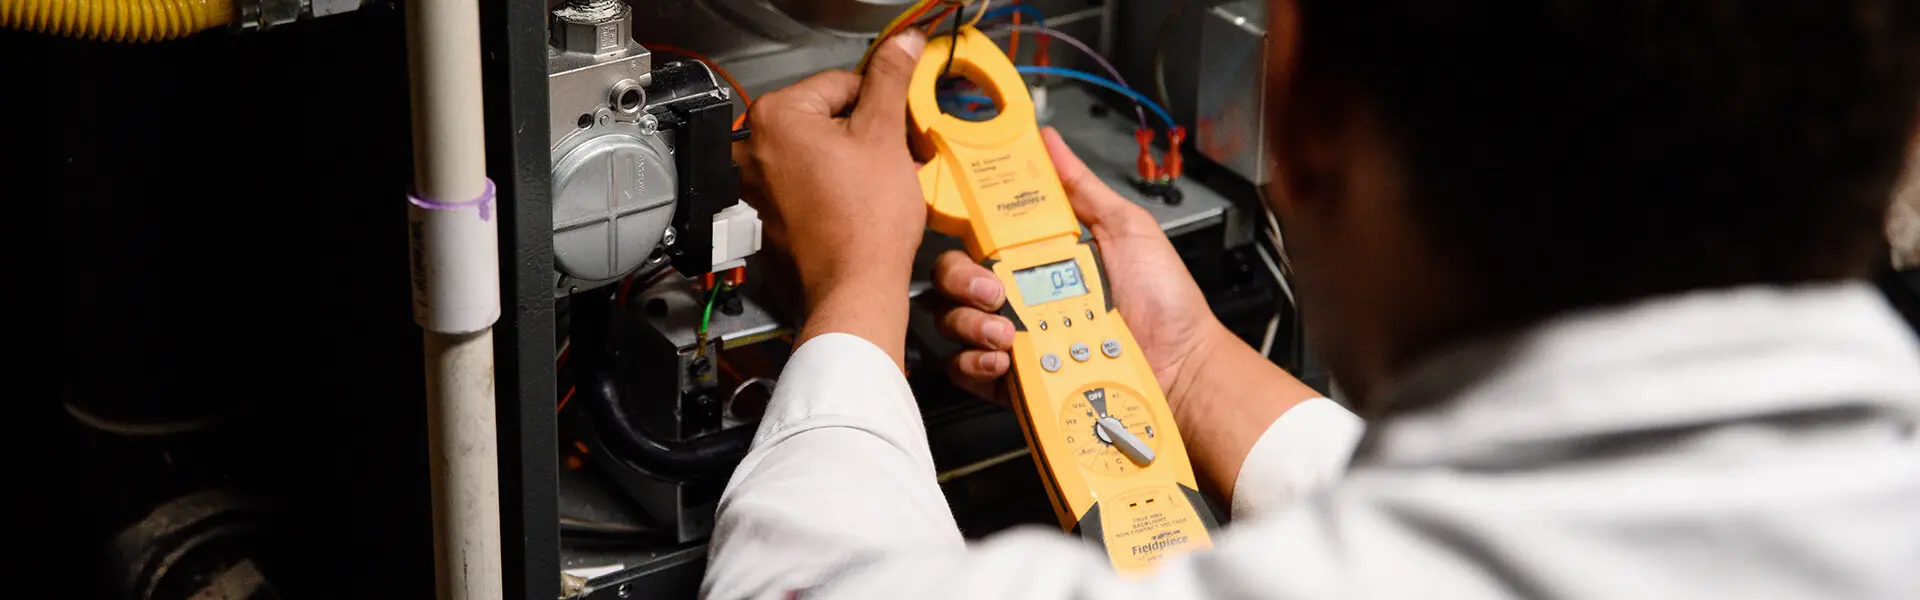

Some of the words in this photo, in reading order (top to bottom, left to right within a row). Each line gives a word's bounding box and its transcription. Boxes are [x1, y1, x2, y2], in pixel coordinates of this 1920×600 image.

[1072, 345, 1089, 356] NCV
[1088, 391, 1103, 401] OFF
[1132, 514, 1148, 523] TRUE
[1132, 517, 1167, 529] BACKLIGHT
[1131, 535, 1189, 556] Fieldpiece
